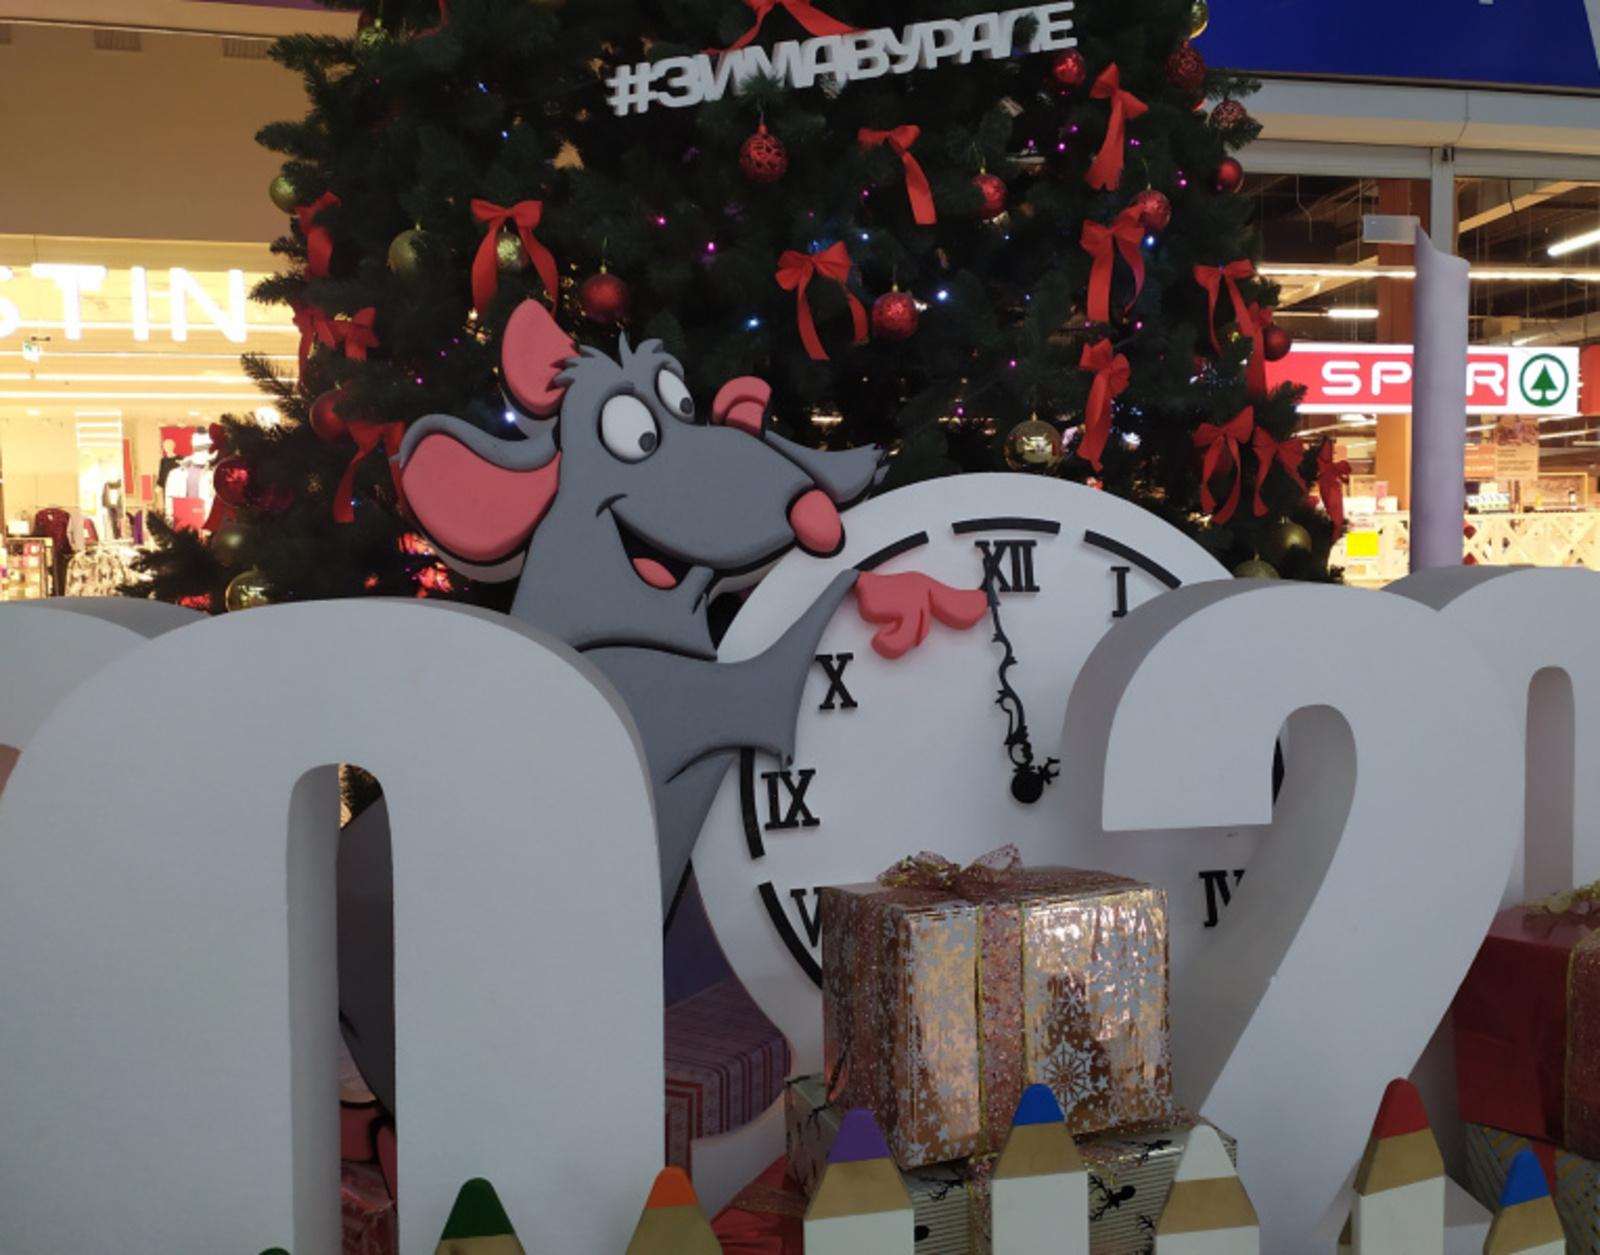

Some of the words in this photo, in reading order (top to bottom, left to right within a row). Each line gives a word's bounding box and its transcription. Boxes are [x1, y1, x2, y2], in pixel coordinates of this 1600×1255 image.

[606, 2, 1078, 116] #ЗИМАВУРАЛЕ
[1321, 361, 1505, 397] SPR
[974, 539, 1040, 593] XII
[815, 652, 858, 710] X
[761, 768, 820, 830] IX
